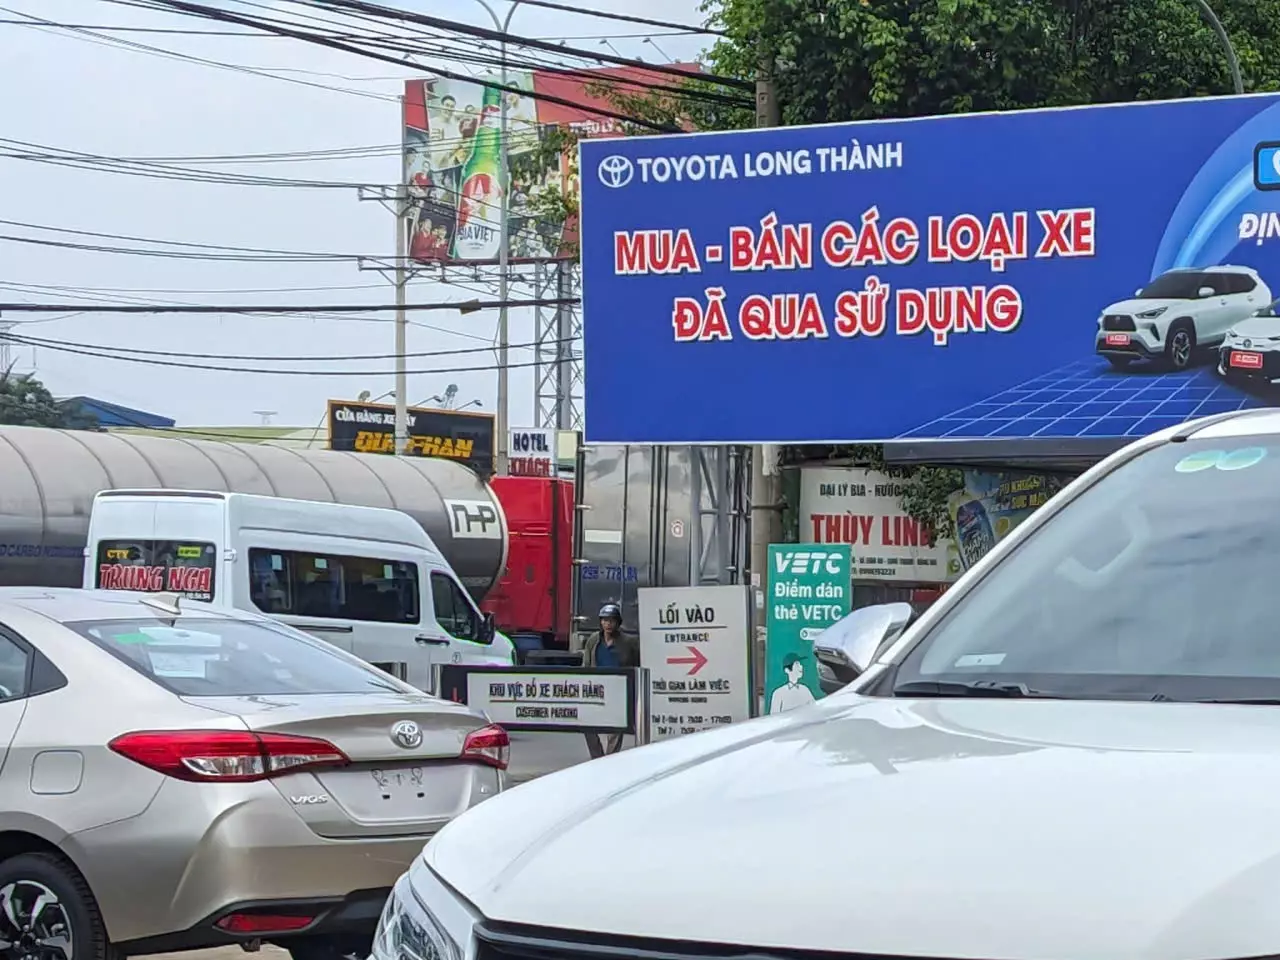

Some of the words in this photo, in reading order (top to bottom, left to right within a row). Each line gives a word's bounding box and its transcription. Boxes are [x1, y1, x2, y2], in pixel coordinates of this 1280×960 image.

[637, 155, 738, 184] TOYOTA
[743, 149, 812, 178] LONG
[819, 138, 904, 172] THÀNH
[613, 228, 701, 275] MUA
[728, 210, 814, 272] BÁN
[820, 205, 920, 268] CÁC
[928, 210, 1028, 272] LOẠI
[1035, 207, 1096, 258] XE
[672, 285, 733, 342] ĐÃ
[739, 292, 828, 340] QUA
[834, 275, 889, 338] SỬ
[896, 284, 1023, 346] DỤNG
[513, 432, 549, 452] HOTEL
[810, 510, 874, 545] THÙY
[775, 552, 843, 575] VETC
[100, 563, 165, 591] TRUNG
[167, 566, 212, 592] NGA
[775, 578, 812, 598] Điểm
[816, 581, 843, 598] dán
[659, 602, 680, 625] LỐI
[685, 603, 715, 624] VÀO
[774, 602, 799, 620] thẻ
[801, 604, 843, 621] VETC
